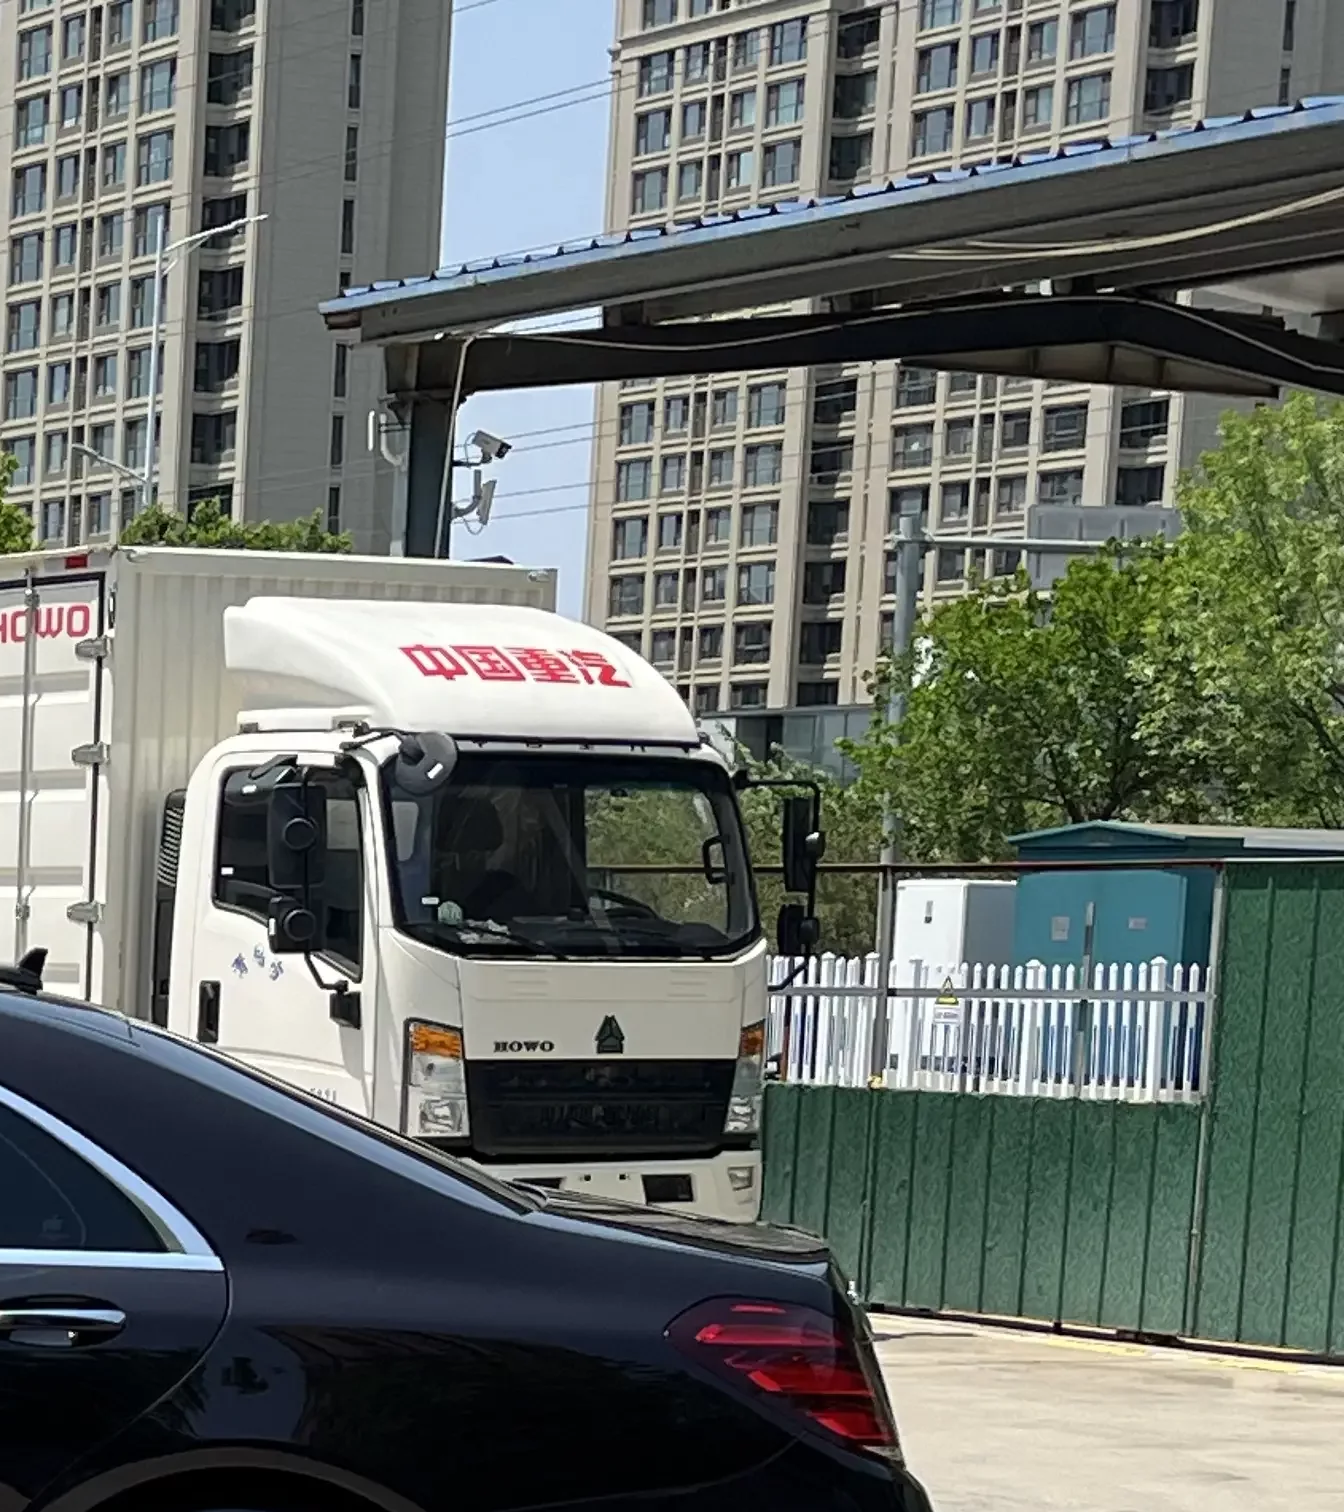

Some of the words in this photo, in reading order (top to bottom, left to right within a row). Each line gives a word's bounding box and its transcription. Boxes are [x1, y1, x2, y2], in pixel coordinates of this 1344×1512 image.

[398, 644, 633, 688] 中国重汽
[493, 1040, 555, 1053] HOWO
